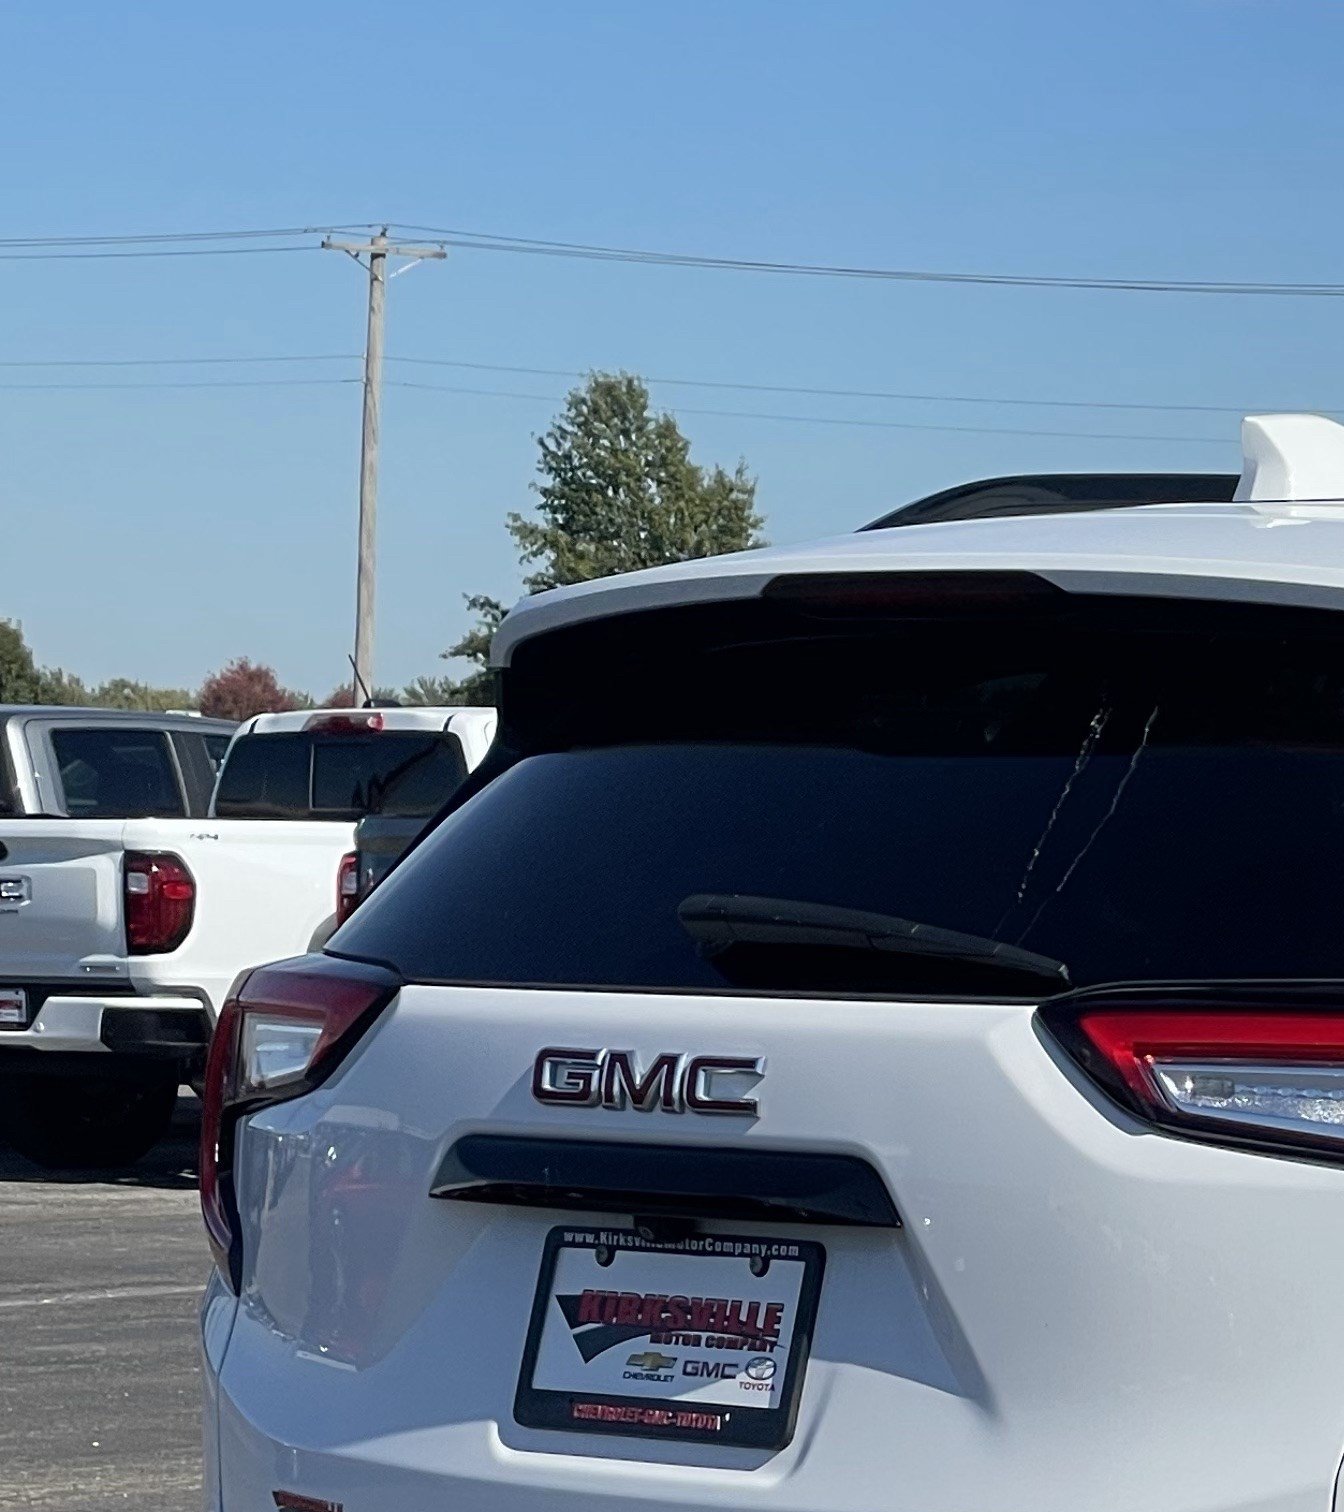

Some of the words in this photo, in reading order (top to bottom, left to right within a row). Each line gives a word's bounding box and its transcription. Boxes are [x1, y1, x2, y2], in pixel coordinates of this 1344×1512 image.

[532, 1046, 768, 1116] GMC
[578, 1289, 785, 1339] KIRKSVILLE
[622, 1370, 675, 1382] CHEVROLET
[682, 1360, 738, 1379] GMC
[738, 1381, 775, 1392] TOYOTA
